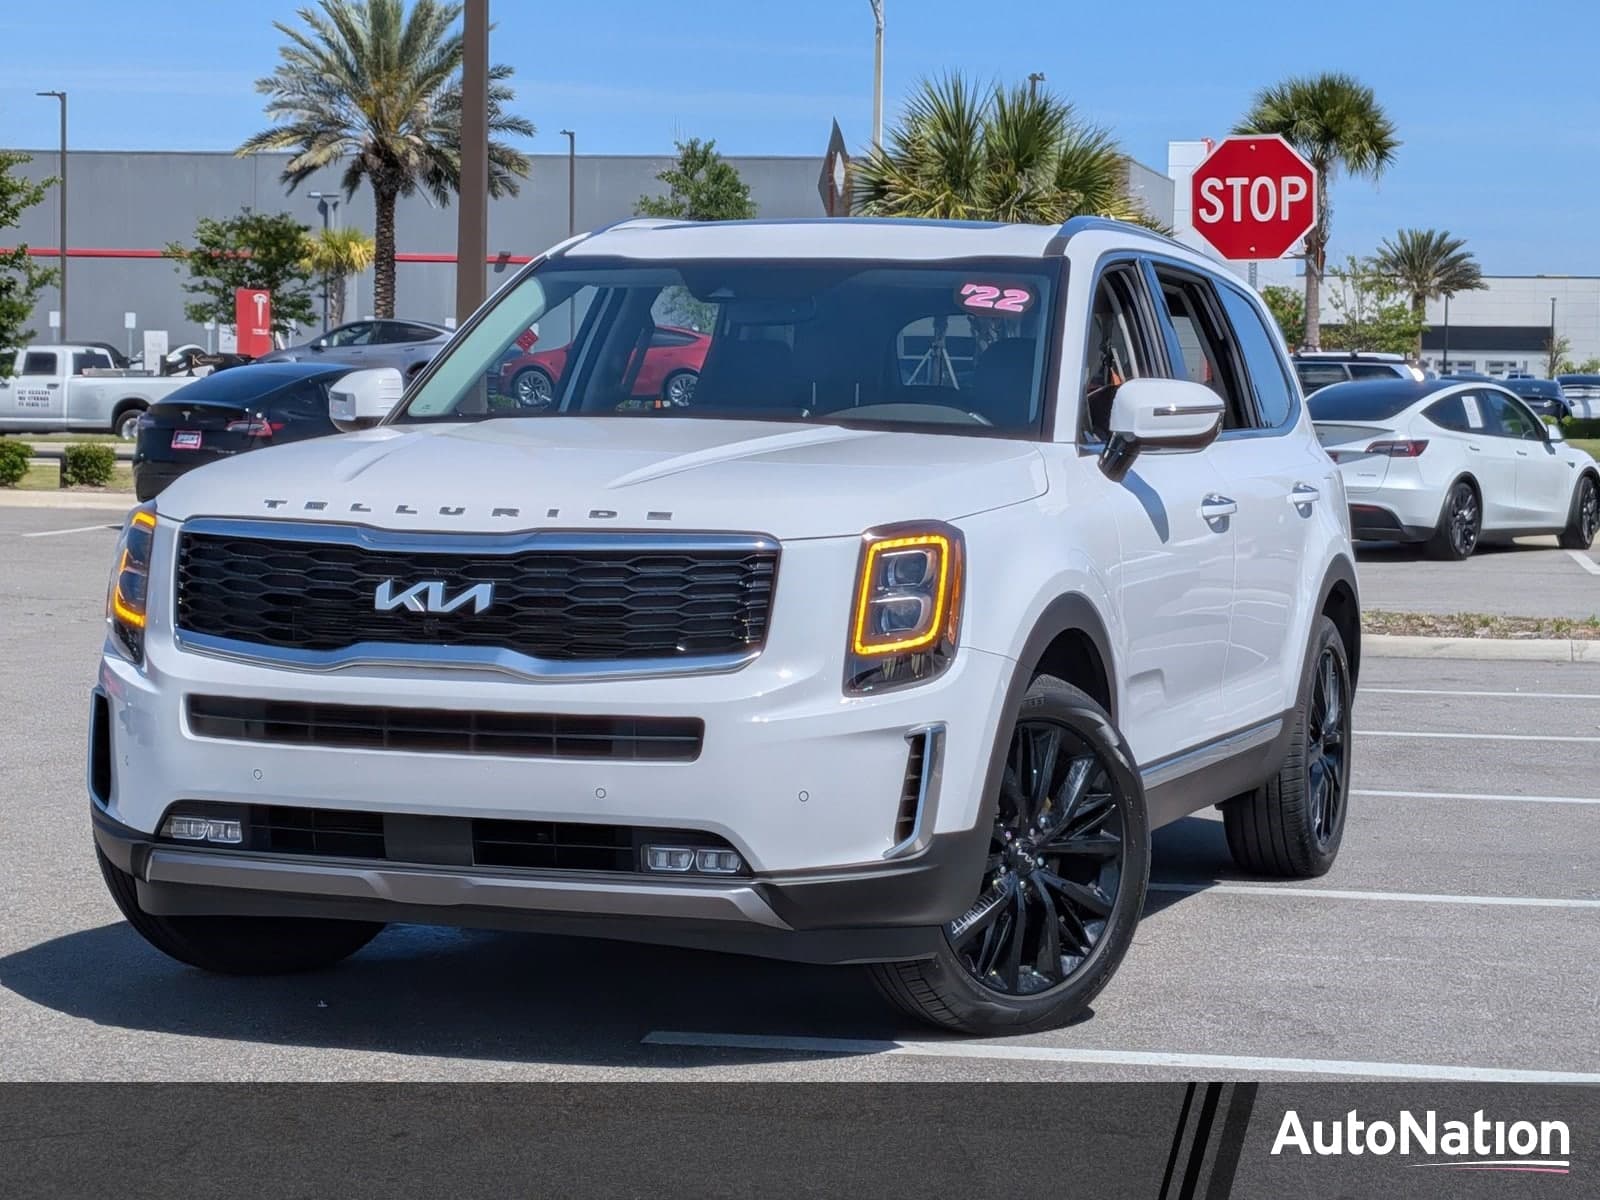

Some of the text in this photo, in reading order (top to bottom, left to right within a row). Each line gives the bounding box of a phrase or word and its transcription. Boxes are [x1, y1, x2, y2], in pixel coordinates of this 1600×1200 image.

[1199, 176, 1307, 223] STOP
[961, 284, 1030, 312] '22
[264, 499, 673, 521] TELLURIDE
[375, 578, 492, 614] KIA
